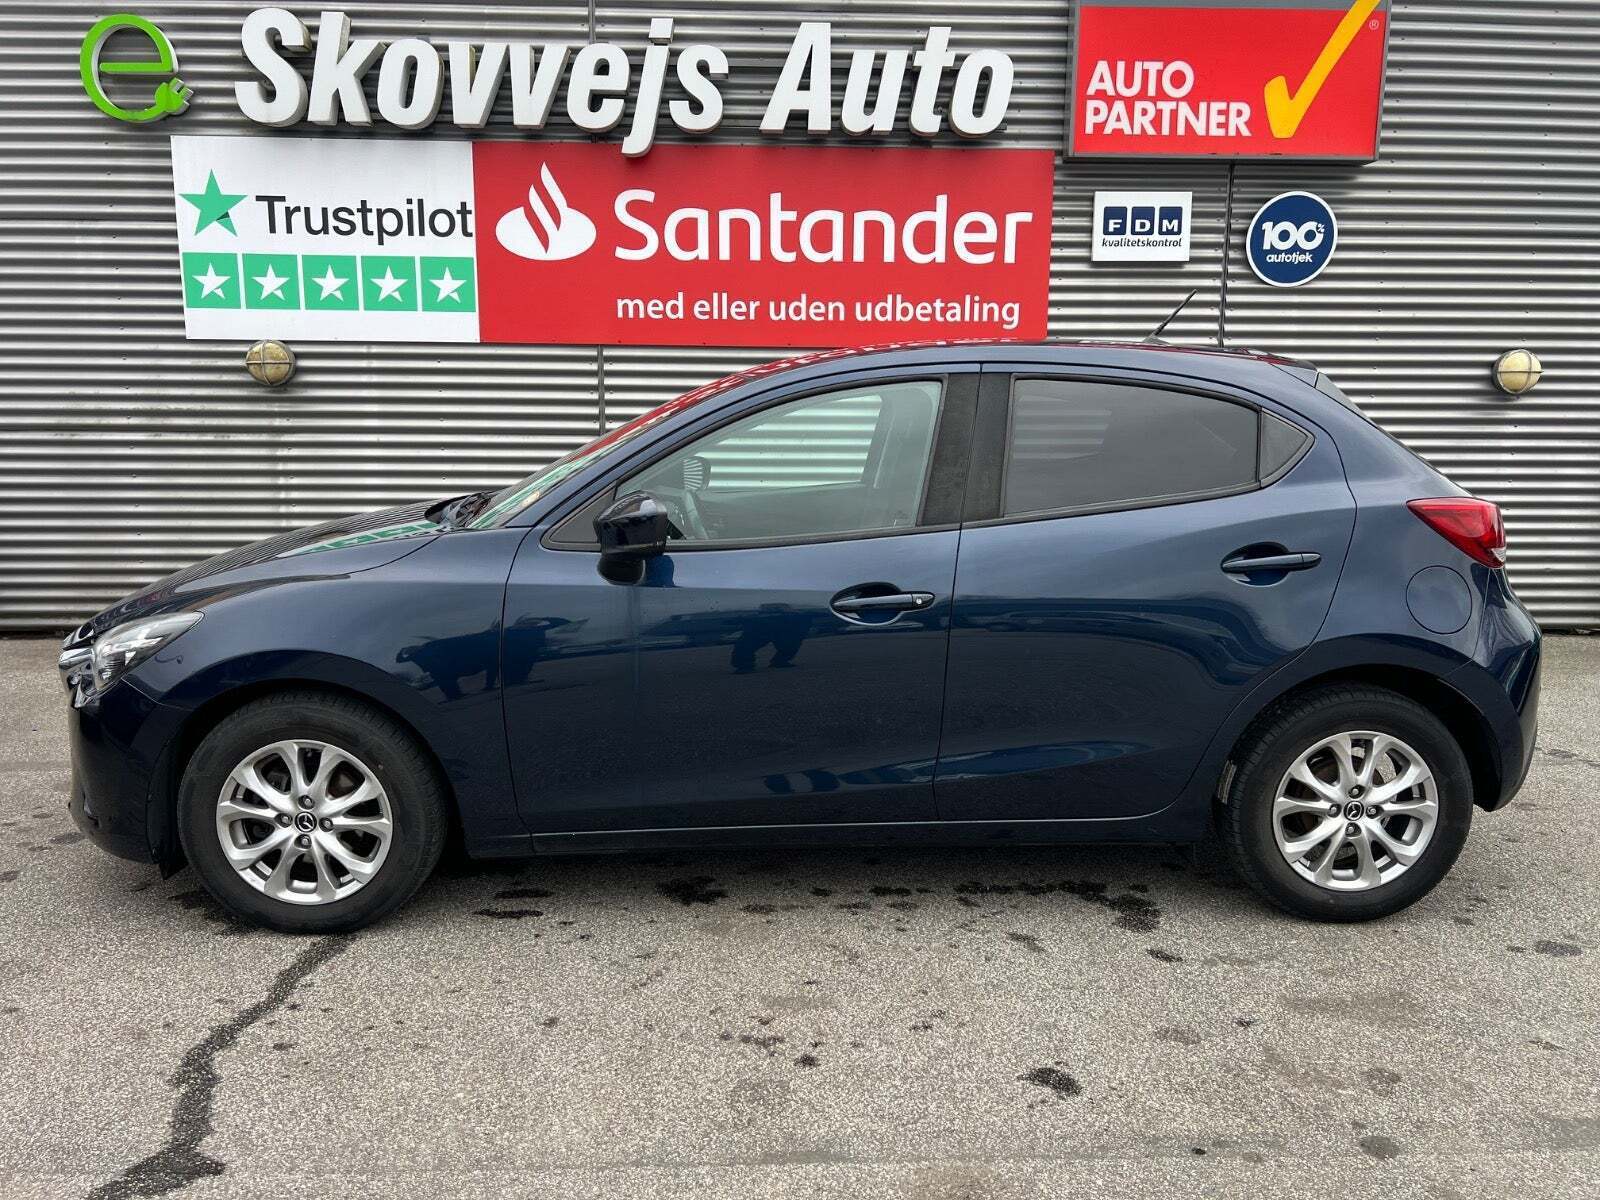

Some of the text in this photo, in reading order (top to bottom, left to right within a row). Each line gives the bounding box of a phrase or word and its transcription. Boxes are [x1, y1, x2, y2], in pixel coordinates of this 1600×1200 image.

[234, 7, 1015, 157] Skovvejs Auto
[1086, 60, 1195, 98] AUTO
[1084, 99, 1252, 137] PARTNER
[255, 194, 474, 246] Trustpilot
[614, 189, 1033, 264] Santander
[1102, 237, 1182, 248] kvalitetskontrol
[1266, 252, 1313, 265] autotjek
[616, 292, 1020, 330] med eller uden udbetaling
